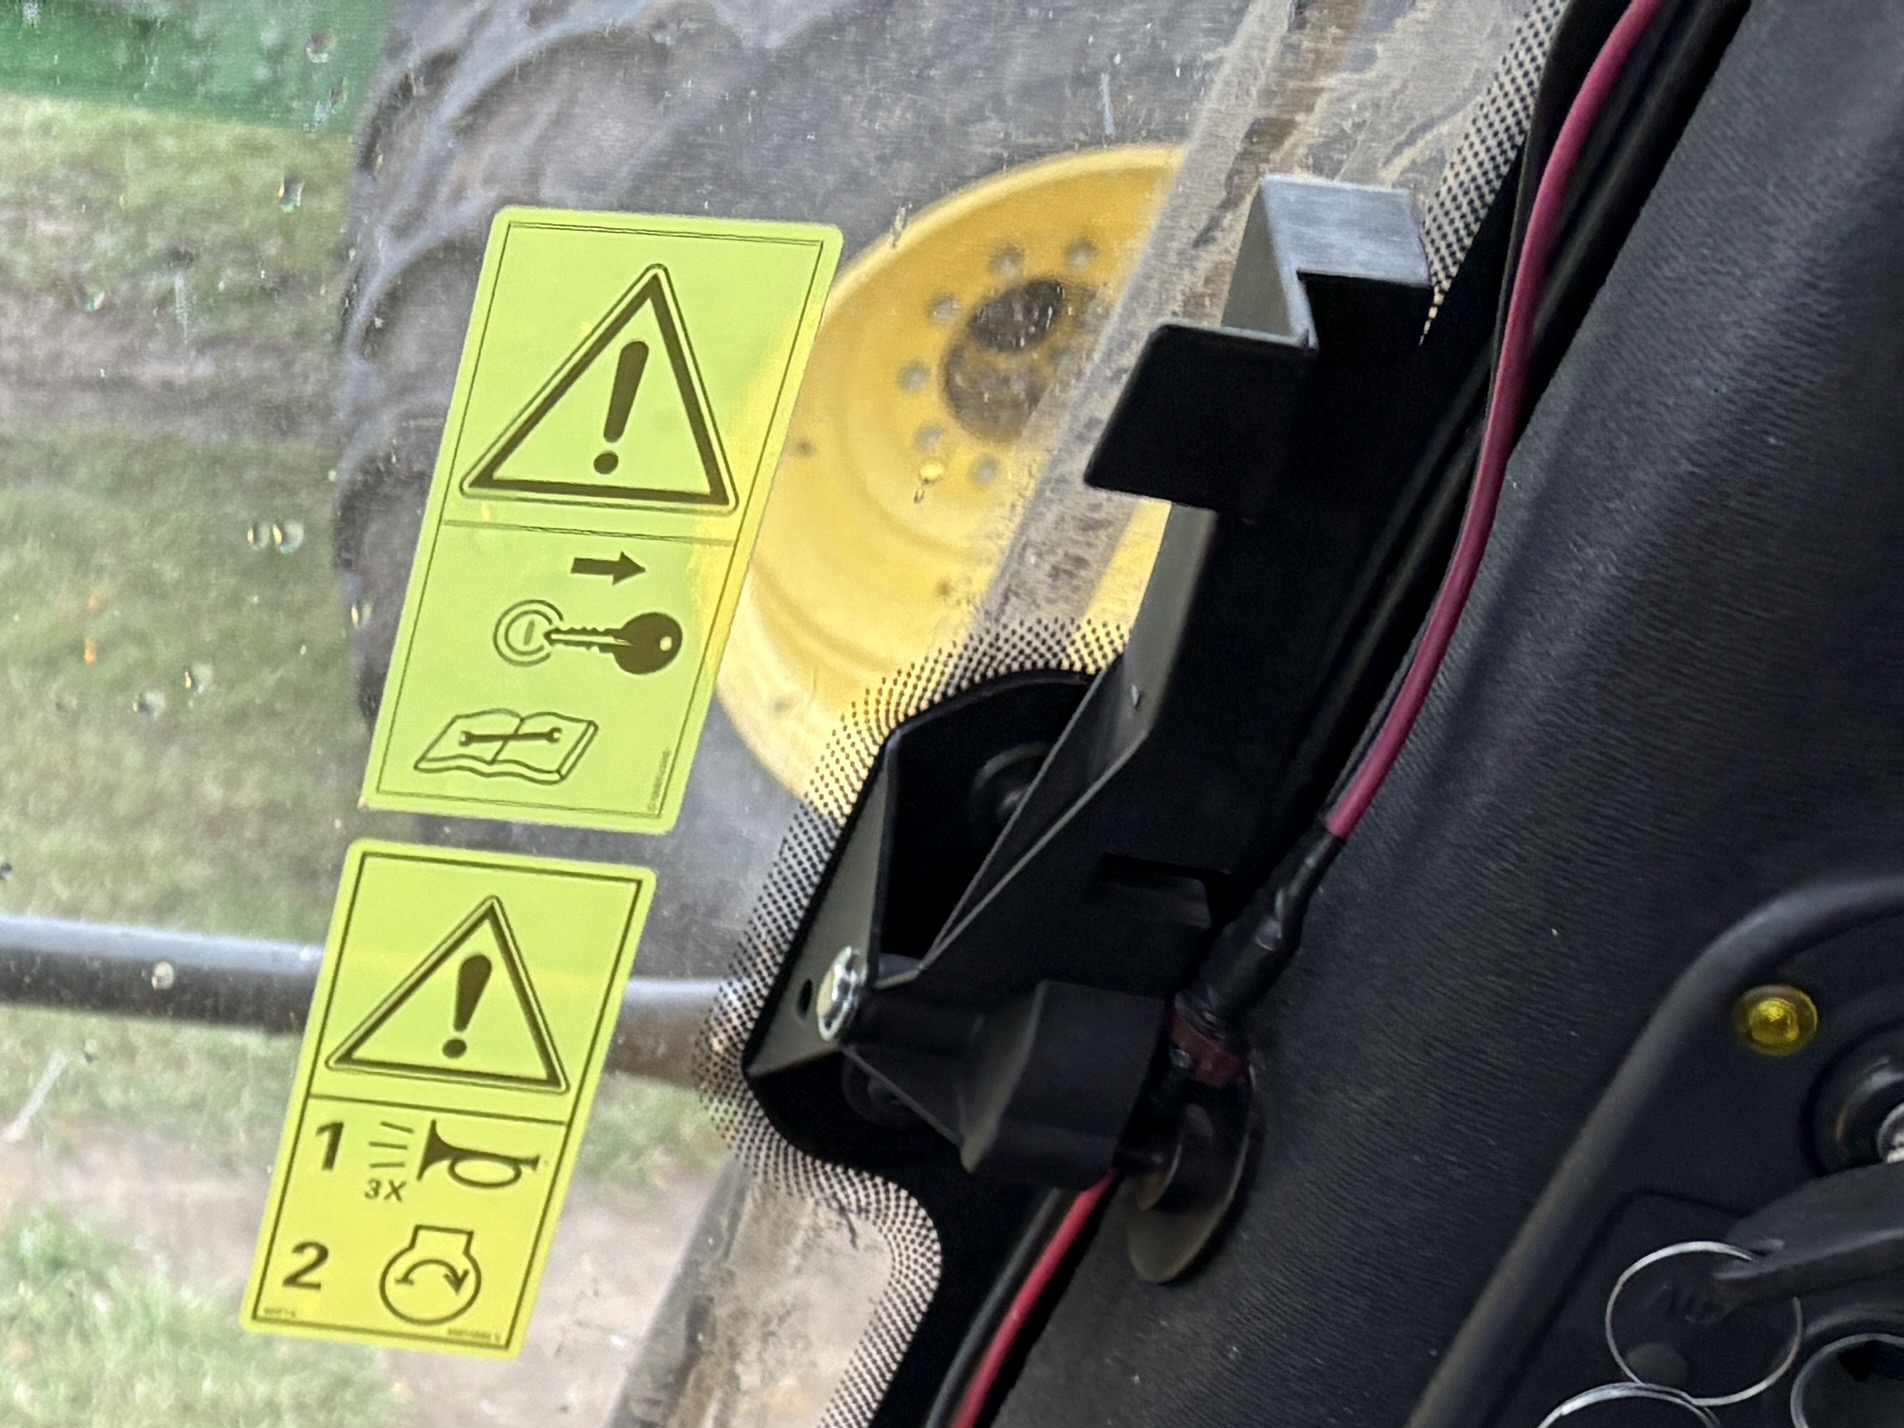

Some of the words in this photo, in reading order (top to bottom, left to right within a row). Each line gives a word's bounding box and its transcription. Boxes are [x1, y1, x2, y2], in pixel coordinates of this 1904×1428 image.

[314, 1121, 346, 1172] 1
[363, 1179, 408, 1204] 3X
[281, 1241, 330, 1291] 2
